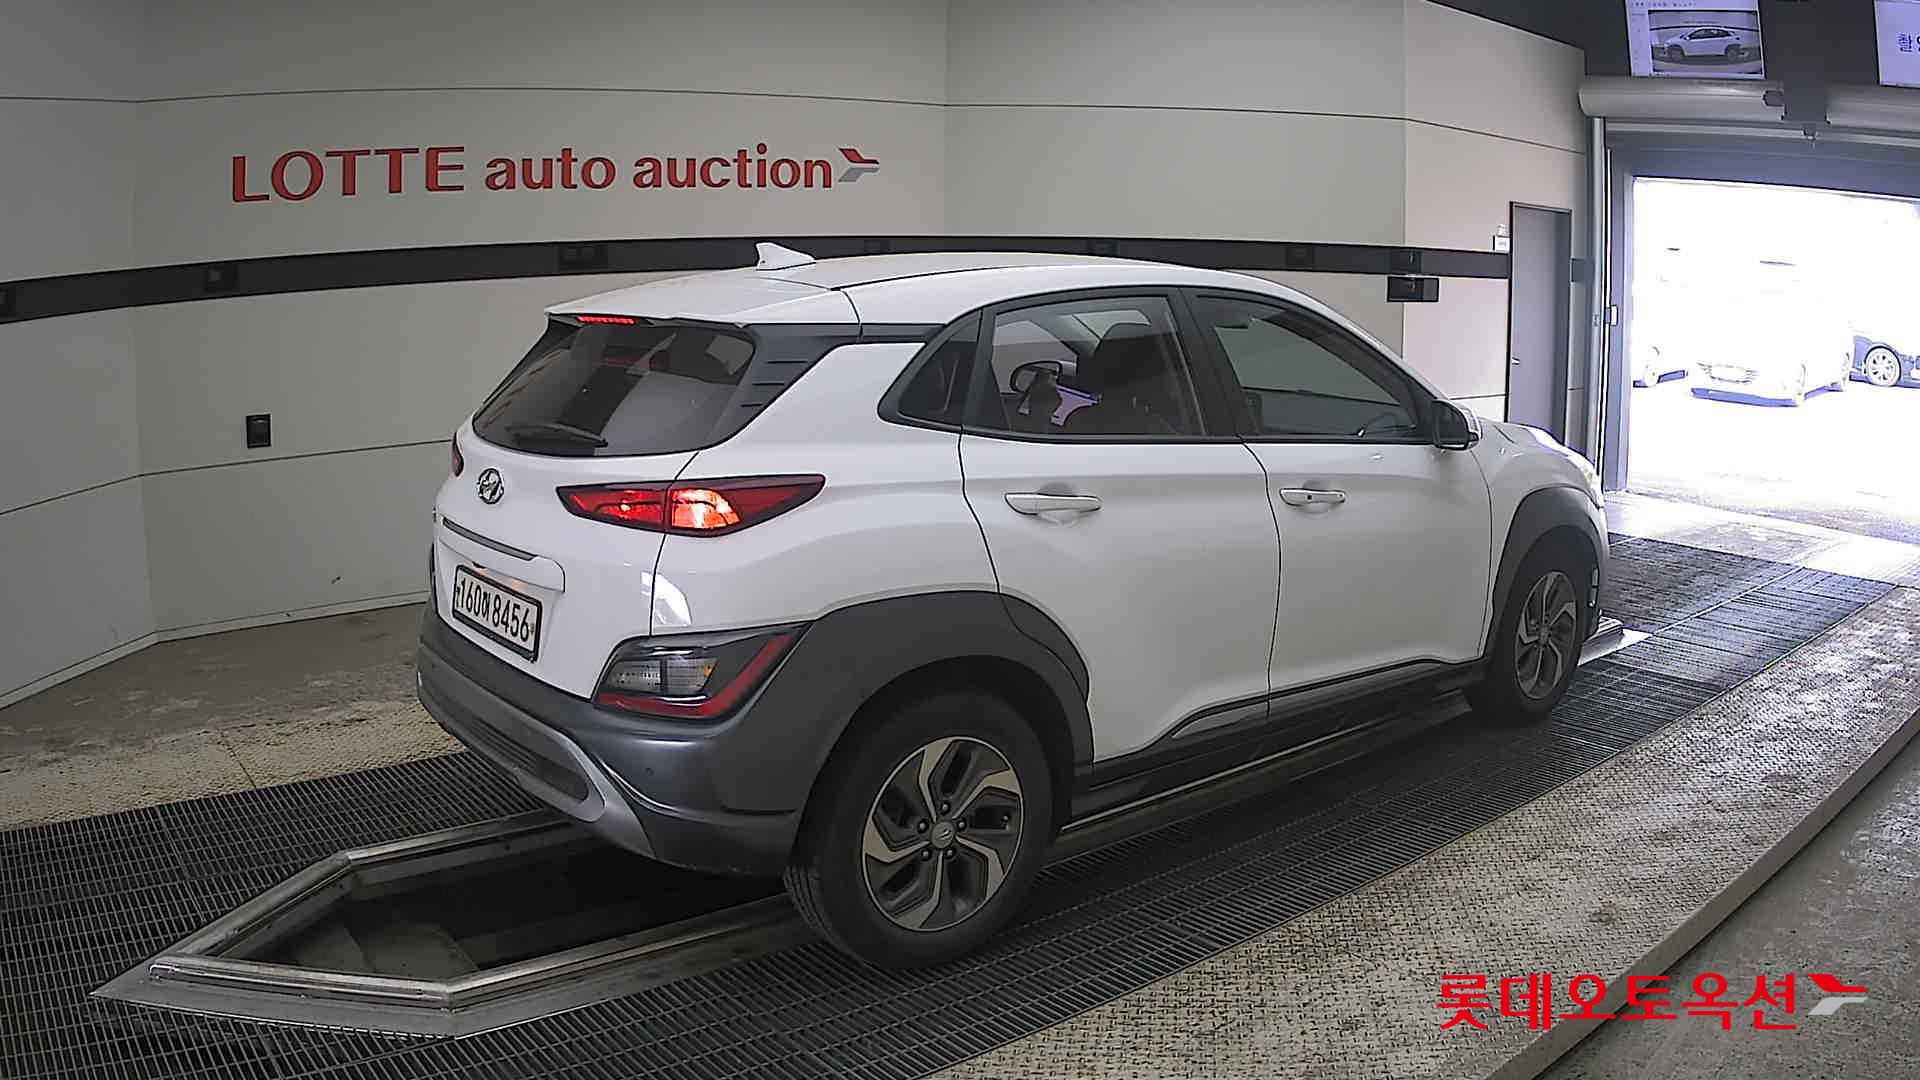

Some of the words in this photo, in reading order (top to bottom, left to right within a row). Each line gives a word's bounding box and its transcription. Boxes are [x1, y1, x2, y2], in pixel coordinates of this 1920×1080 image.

[232, 147, 465, 202] LOTTE
[486, 148, 617, 191] auto
[632, 143, 833, 189] auction
